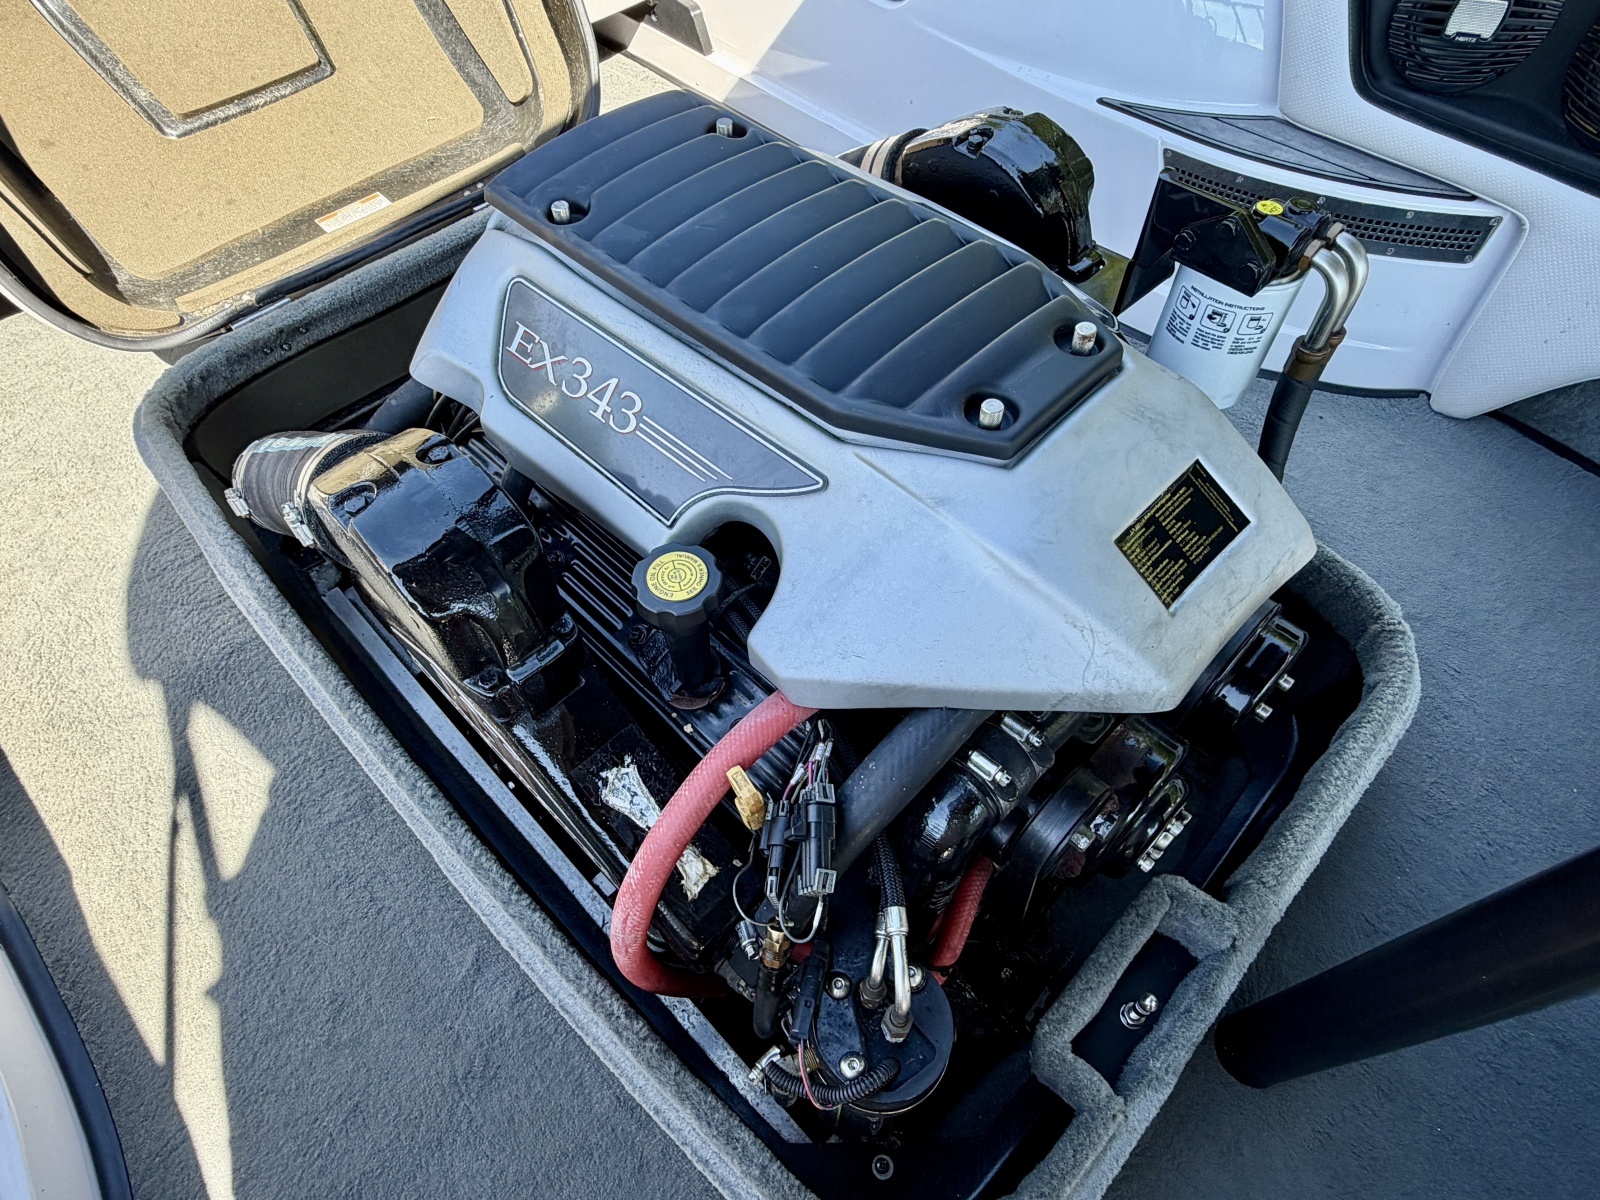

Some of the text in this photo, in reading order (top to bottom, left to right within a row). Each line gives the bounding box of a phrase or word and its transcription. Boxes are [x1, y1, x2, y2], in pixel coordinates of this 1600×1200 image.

[1191, 285, 1265, 311] INSTALLATION INSTRUCTIONS
[506, 321, 643, 434] EX343
[653, 560, 665, 570] FILL
[675, 554, 698, 564] MANUAL
[651, 582, 674, 598] ENGINE
[686, 586, 698, 595] SEE
